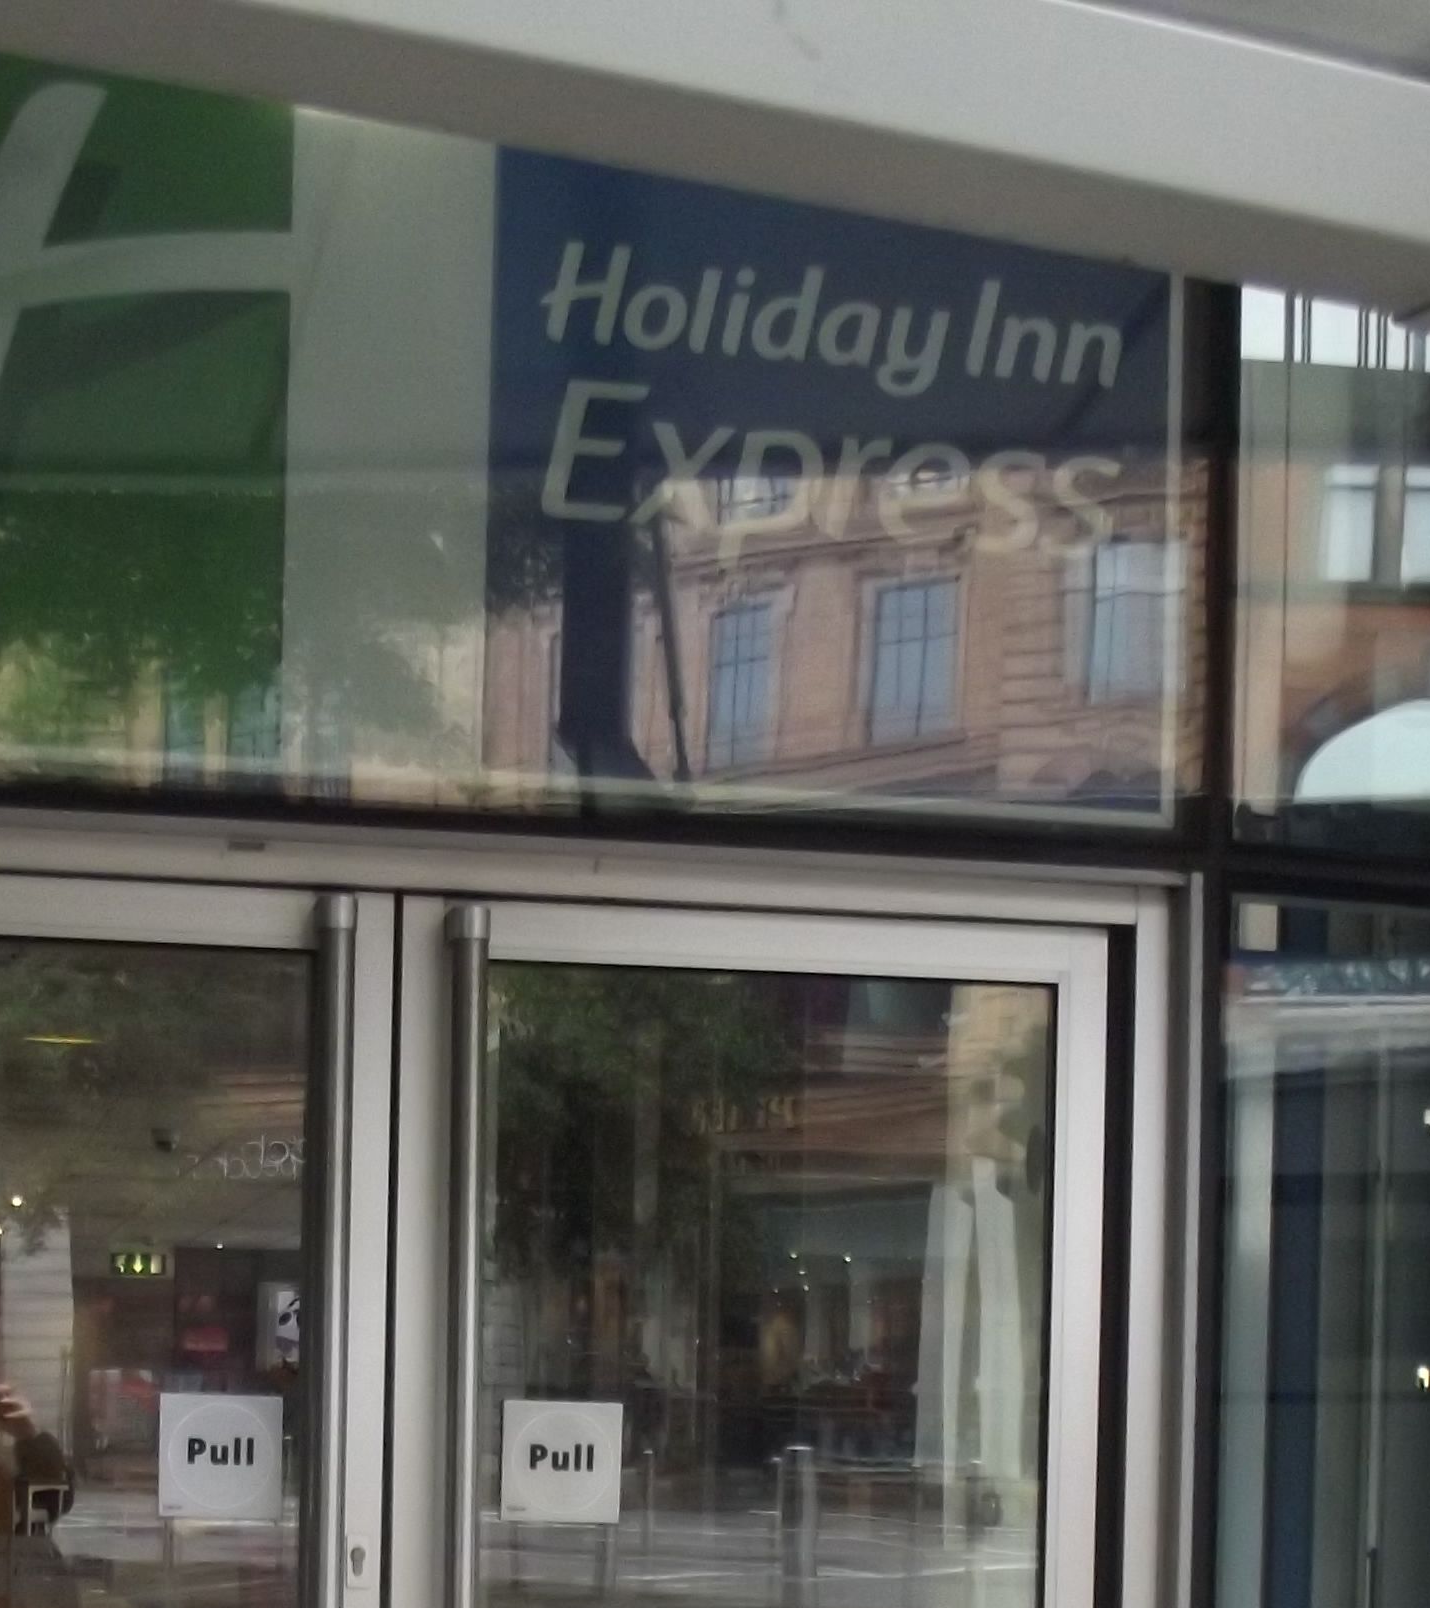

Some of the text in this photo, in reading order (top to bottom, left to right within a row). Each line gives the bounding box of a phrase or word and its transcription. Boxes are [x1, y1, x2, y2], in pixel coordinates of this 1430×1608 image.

[540, 240, 1123, 397] Holiday Inn
[541, 378, 1122, 572] Express
[187, 1437, 255, 1467] Pull
[529, 1443, 595, 1473] Pull
